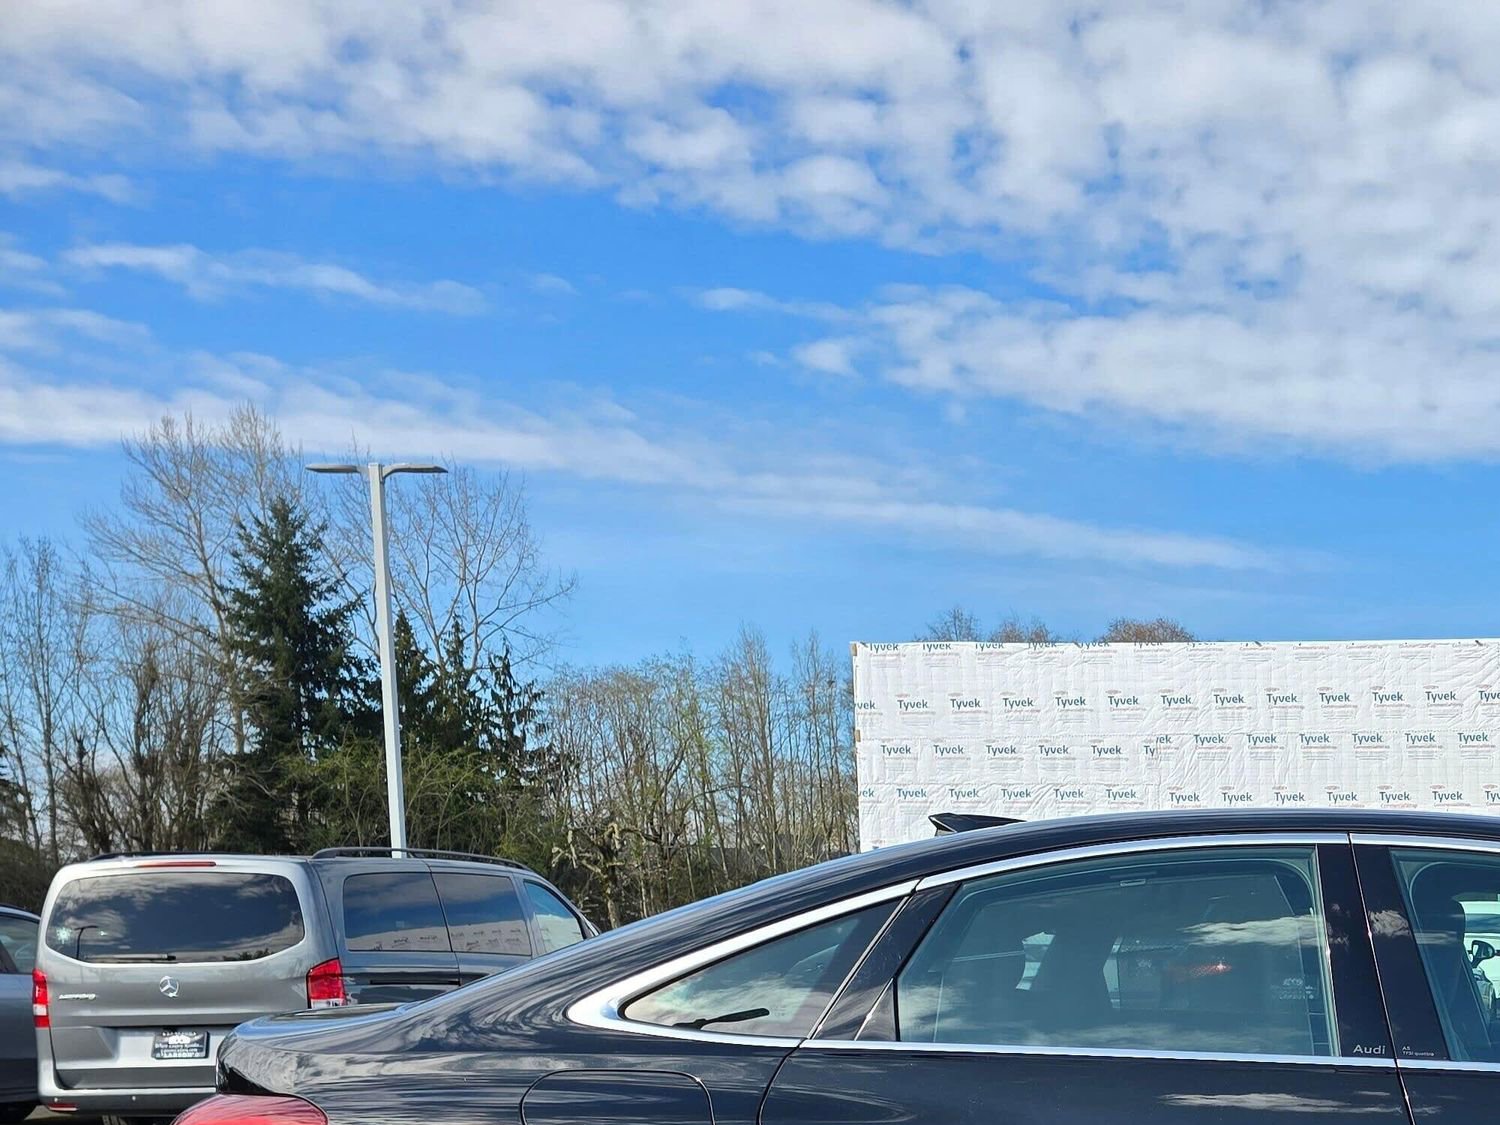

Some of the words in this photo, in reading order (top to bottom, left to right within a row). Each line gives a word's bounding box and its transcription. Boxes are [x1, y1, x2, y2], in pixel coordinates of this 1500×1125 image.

[1055, 696, 1087, 709] Tyvek
[1107, 695, 1139, 708] Tyvek
[1160, 694, 1192, 707] Tyvek
[1213, 693, 1245, 706] Tyvek
[1266, 693, 1298, 706] Tyvek
[1319, 692, 1351, 705] Tyvek
[1372, 691, 1404, 704] Tyvek
[1425, 690, 1457, 703] Tyvek
[897, 699, 929, 712] Tyvek
[950, 698, 982, 711] Tyvek
[1002, 697, 1034, 710] Tyvek
[1193, 734, 1225, 747] Tyvek
[1246, 733, 1278, 746] Tyvek
[1299, 733, 1331, 746] Tyvek
[1351, 732, 1383, 745] Tyvek
[1404, 732, 1436, 745] Tyvek
[1457, 731, 1489, 744] Tyvek
[880, 744, 912, 757] Tyvek
[933, 744, 965, 757] Tyvek
[986, 744, 1018, 757] Tyvek
[1038, 744, 1070, 757] Tyvek
[1091, 745, 1123, 758] Tyvek
[896, 788, 928, 801] Tyvek
[948, 788, 980, 801] Tyvek
[1000, 788, 1032, 801] Tyvek
[1053, 788, 1085, 801] Tyvek
[1105, 788, 1137, 801] Tyvek
[1169, 792, 1201, 805] Tyvek
[1221, 791, 1253, 805] Tyvek
[1274, 791, 1306, 805] Tyvek
[1326, 791, 1358, 804] Tyvek
[1379, 791, 1411, 804] Tyvek
[1431, 790, 1463, 803] Tyvek
[1352, 1044, 1386, 1055] Audi
